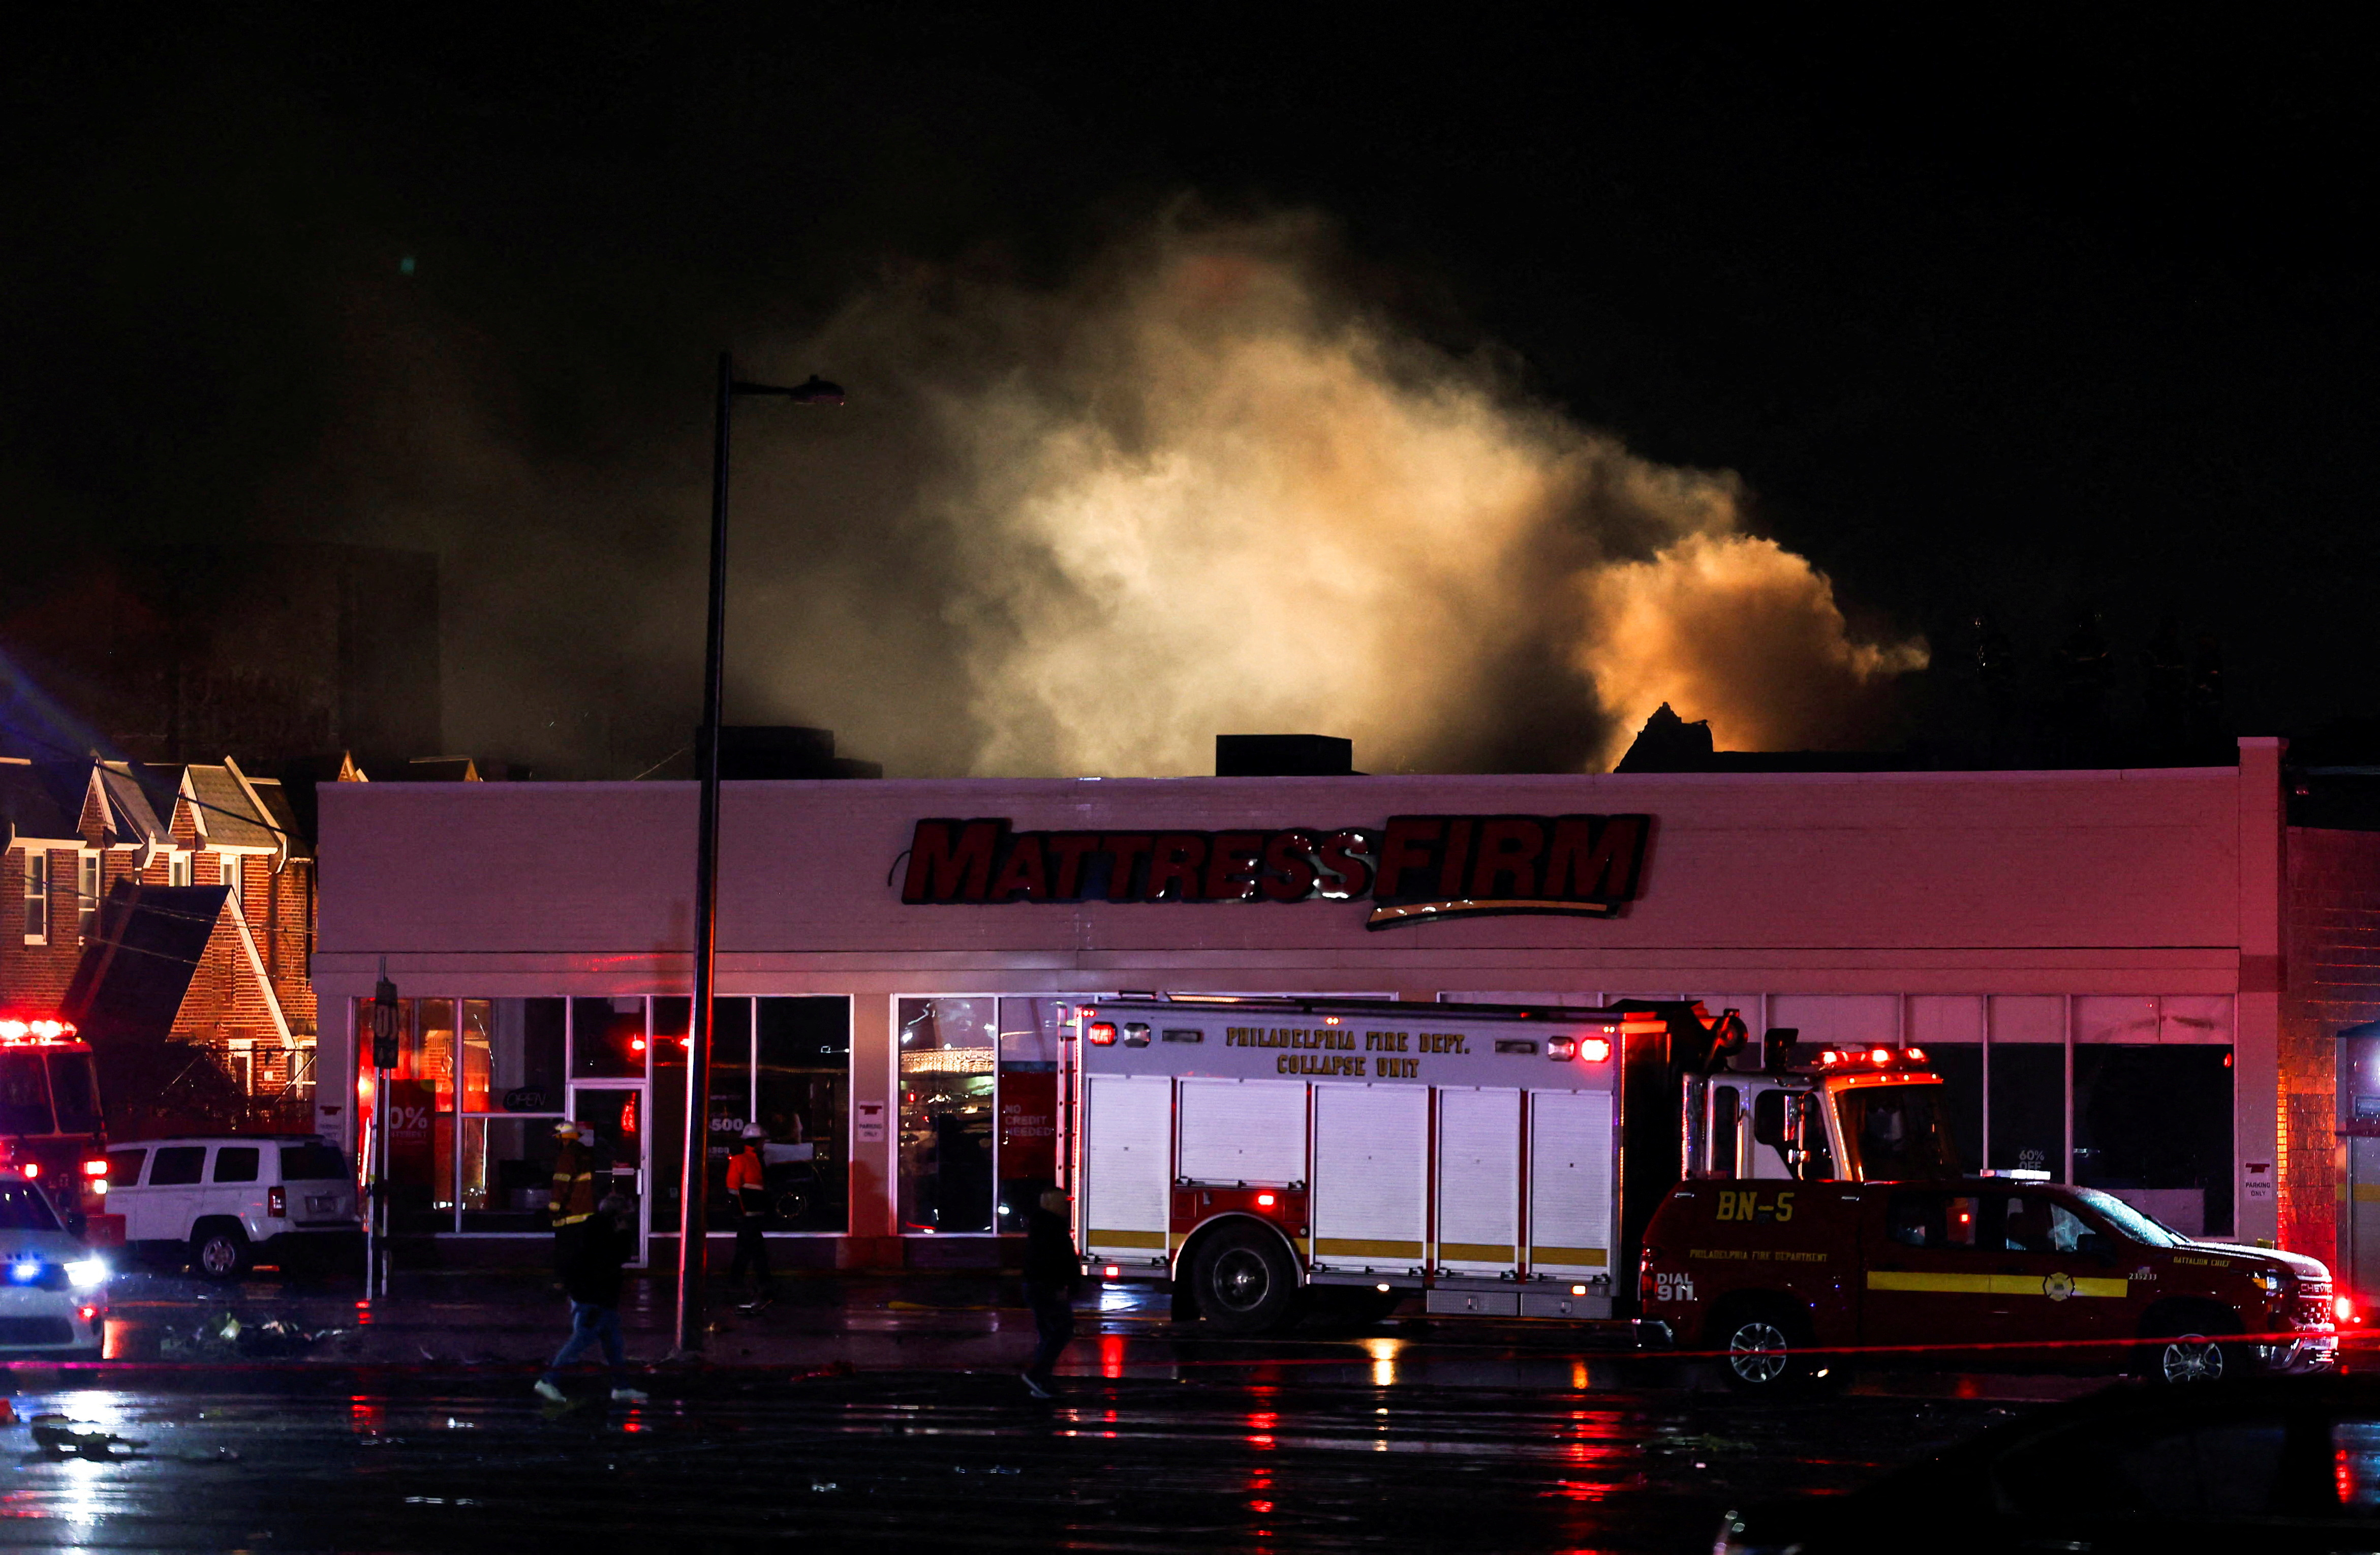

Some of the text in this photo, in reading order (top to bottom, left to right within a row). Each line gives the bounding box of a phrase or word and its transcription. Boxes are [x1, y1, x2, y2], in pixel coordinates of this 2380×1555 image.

[903, 816, 1647, 902] MATTRESS FIRM
[1226, 1027, 1471, 1054] PHILADELPHIA FIRE DEPT.
[1277, 1054, 1419, 1078] COLLAPSE UNIT
[507, 1091, 547, 1107] OPEN
[1005, 1104, 1022, 1114] NO
[2019, 1150, 2045, 1161] 60%
[2019, 1161, 2042, 1170] OFF
[1716, 1191, 1795, 1222] BN-5
[1689, 1249, 1828, 1263] PHILADELPHIA FIRE DEPARTMENT
[2173, 1256, 2208, 1266] BATTALION
[1657, 1272, 1694, 1285] DIAL
[1657, 1285, 1694, 1301] 911
